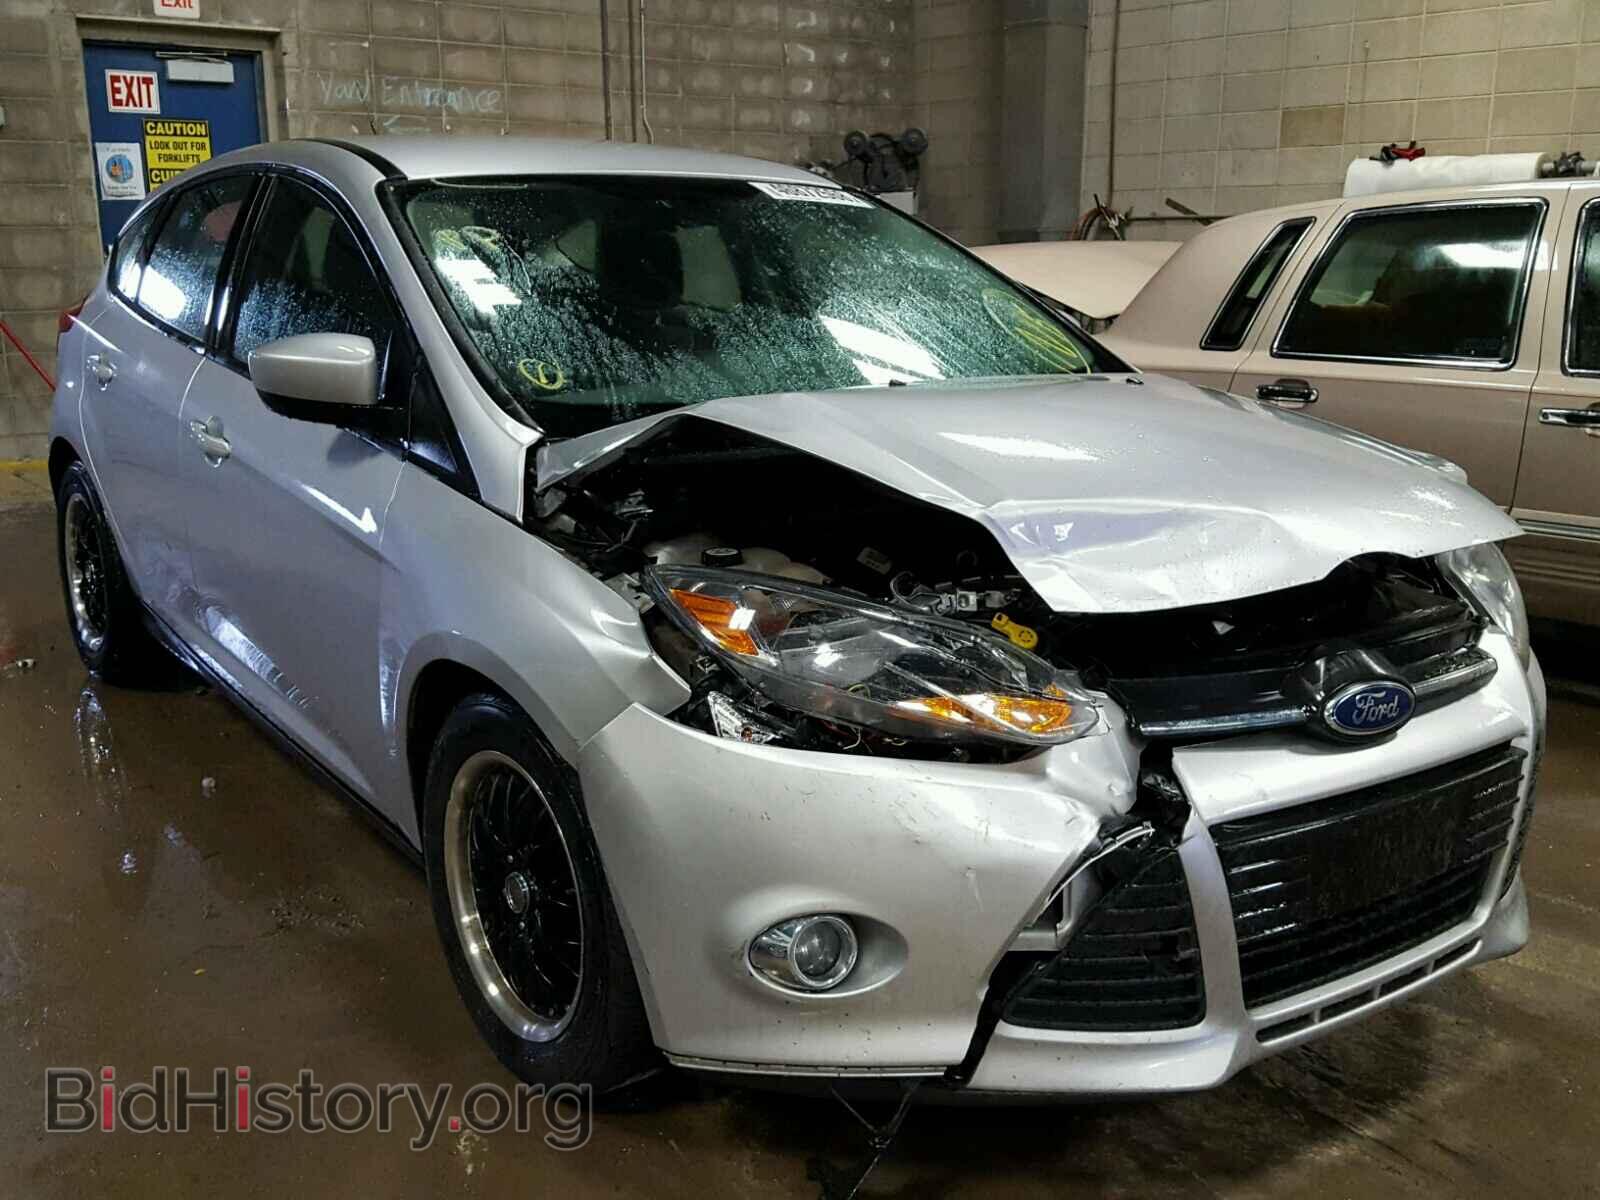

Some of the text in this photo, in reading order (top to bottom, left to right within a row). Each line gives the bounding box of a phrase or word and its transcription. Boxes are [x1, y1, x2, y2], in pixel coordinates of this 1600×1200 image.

[109, 74, 154, 108] EXIT
[146, 122, 207, 136] CAUTION
[149, 140, 207, 151] LOOK OUT FOR
[157, 153, 201, 163] FORKLIFTS
[1351, 690, 1400, 726] Ford
